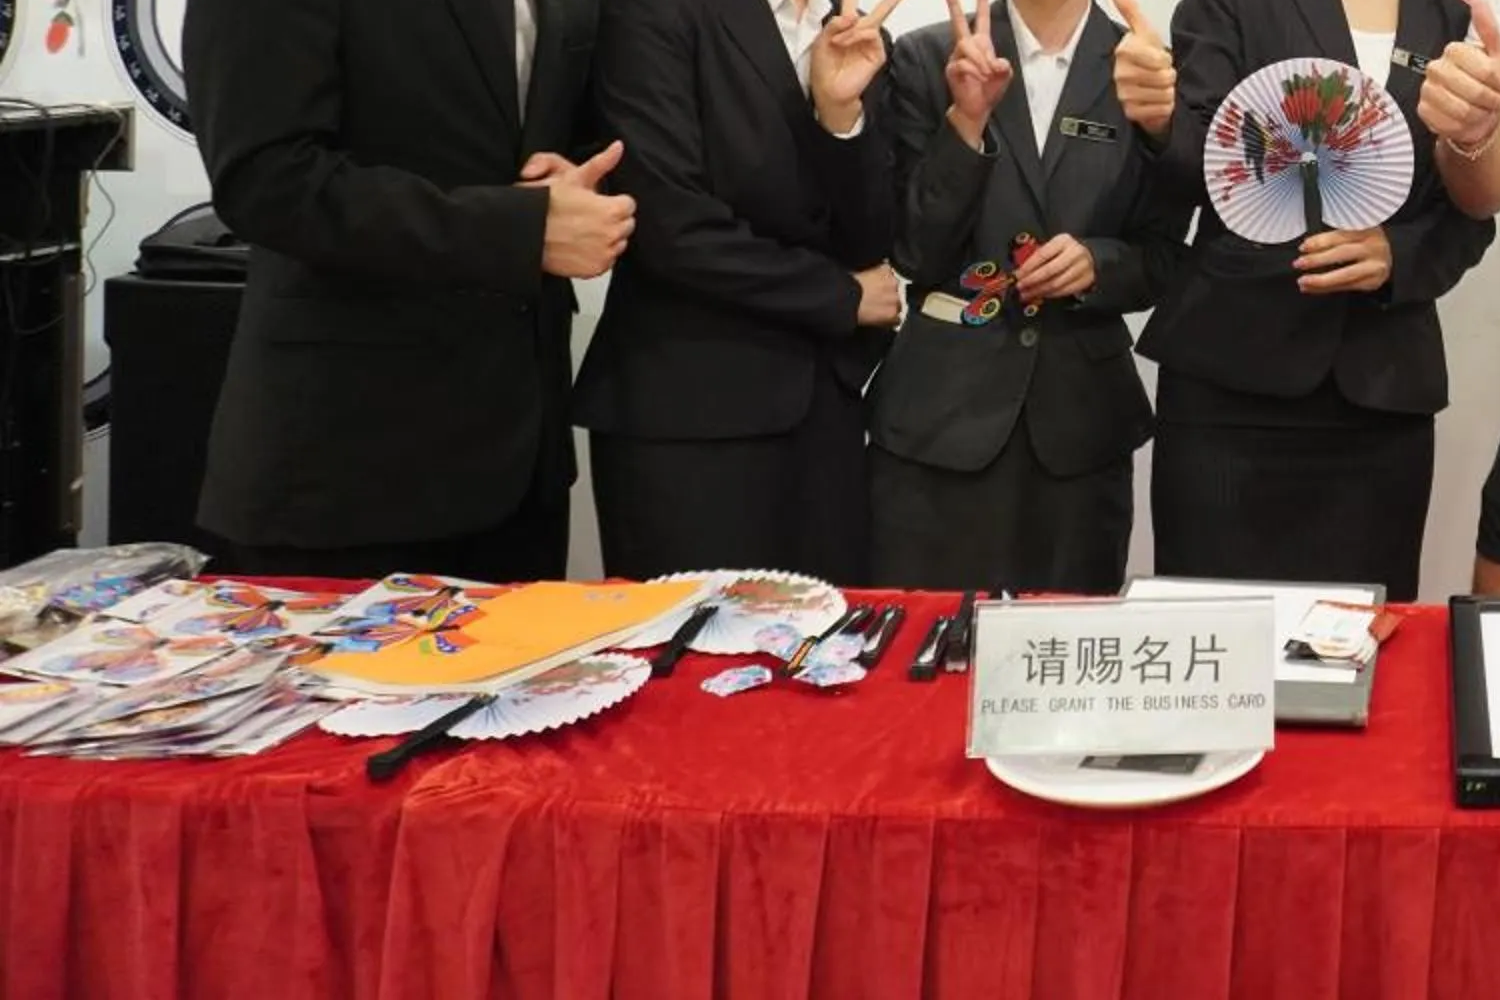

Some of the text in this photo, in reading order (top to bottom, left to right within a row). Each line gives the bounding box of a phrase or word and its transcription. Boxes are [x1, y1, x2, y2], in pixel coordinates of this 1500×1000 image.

[1021, 633, 1228, 686] 请赐名片
[980, 692, 1267, 714] PLEASE GRANT THE BUSINESS CARD
